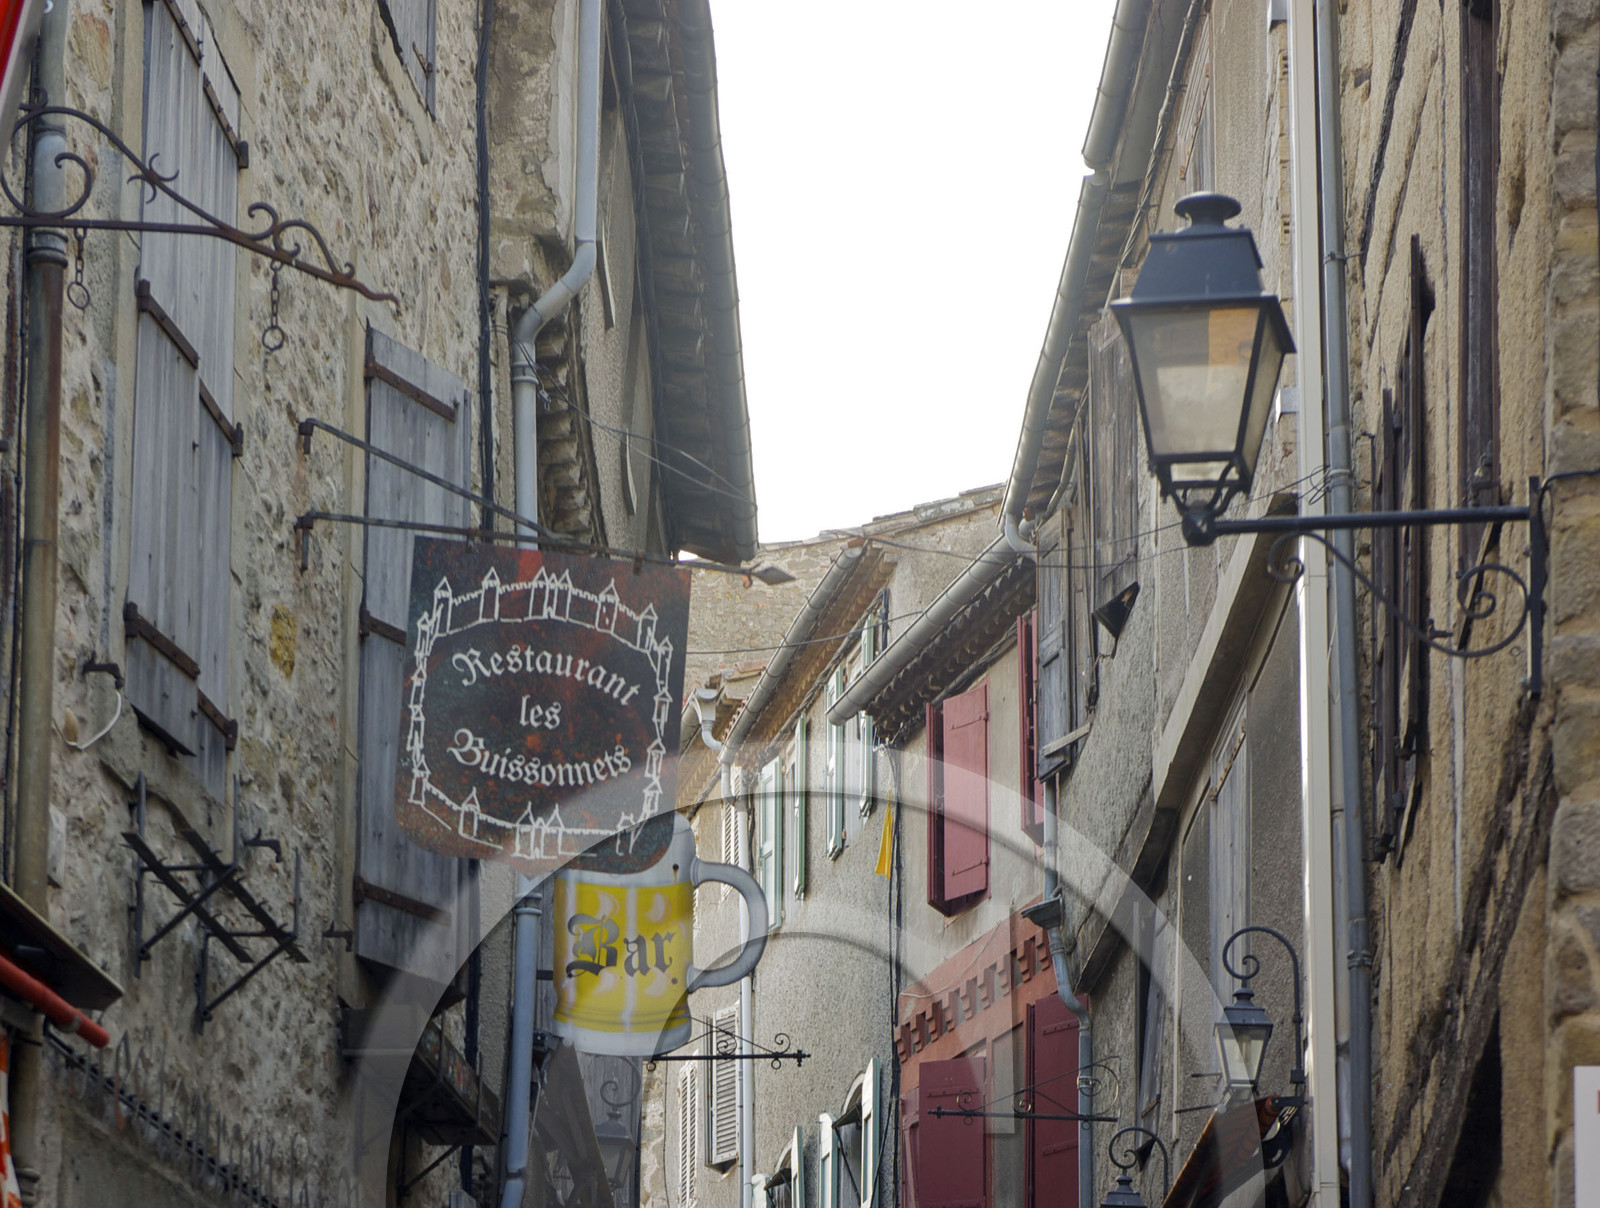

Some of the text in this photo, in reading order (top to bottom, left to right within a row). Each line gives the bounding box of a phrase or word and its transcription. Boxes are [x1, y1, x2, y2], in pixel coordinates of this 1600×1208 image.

[451, 644, 642, 706] Restaurant
[519, 694, 562, 730] les
[446, 728, 632, 787] Buissonnets
[566, 912, 677, 979] Bar
